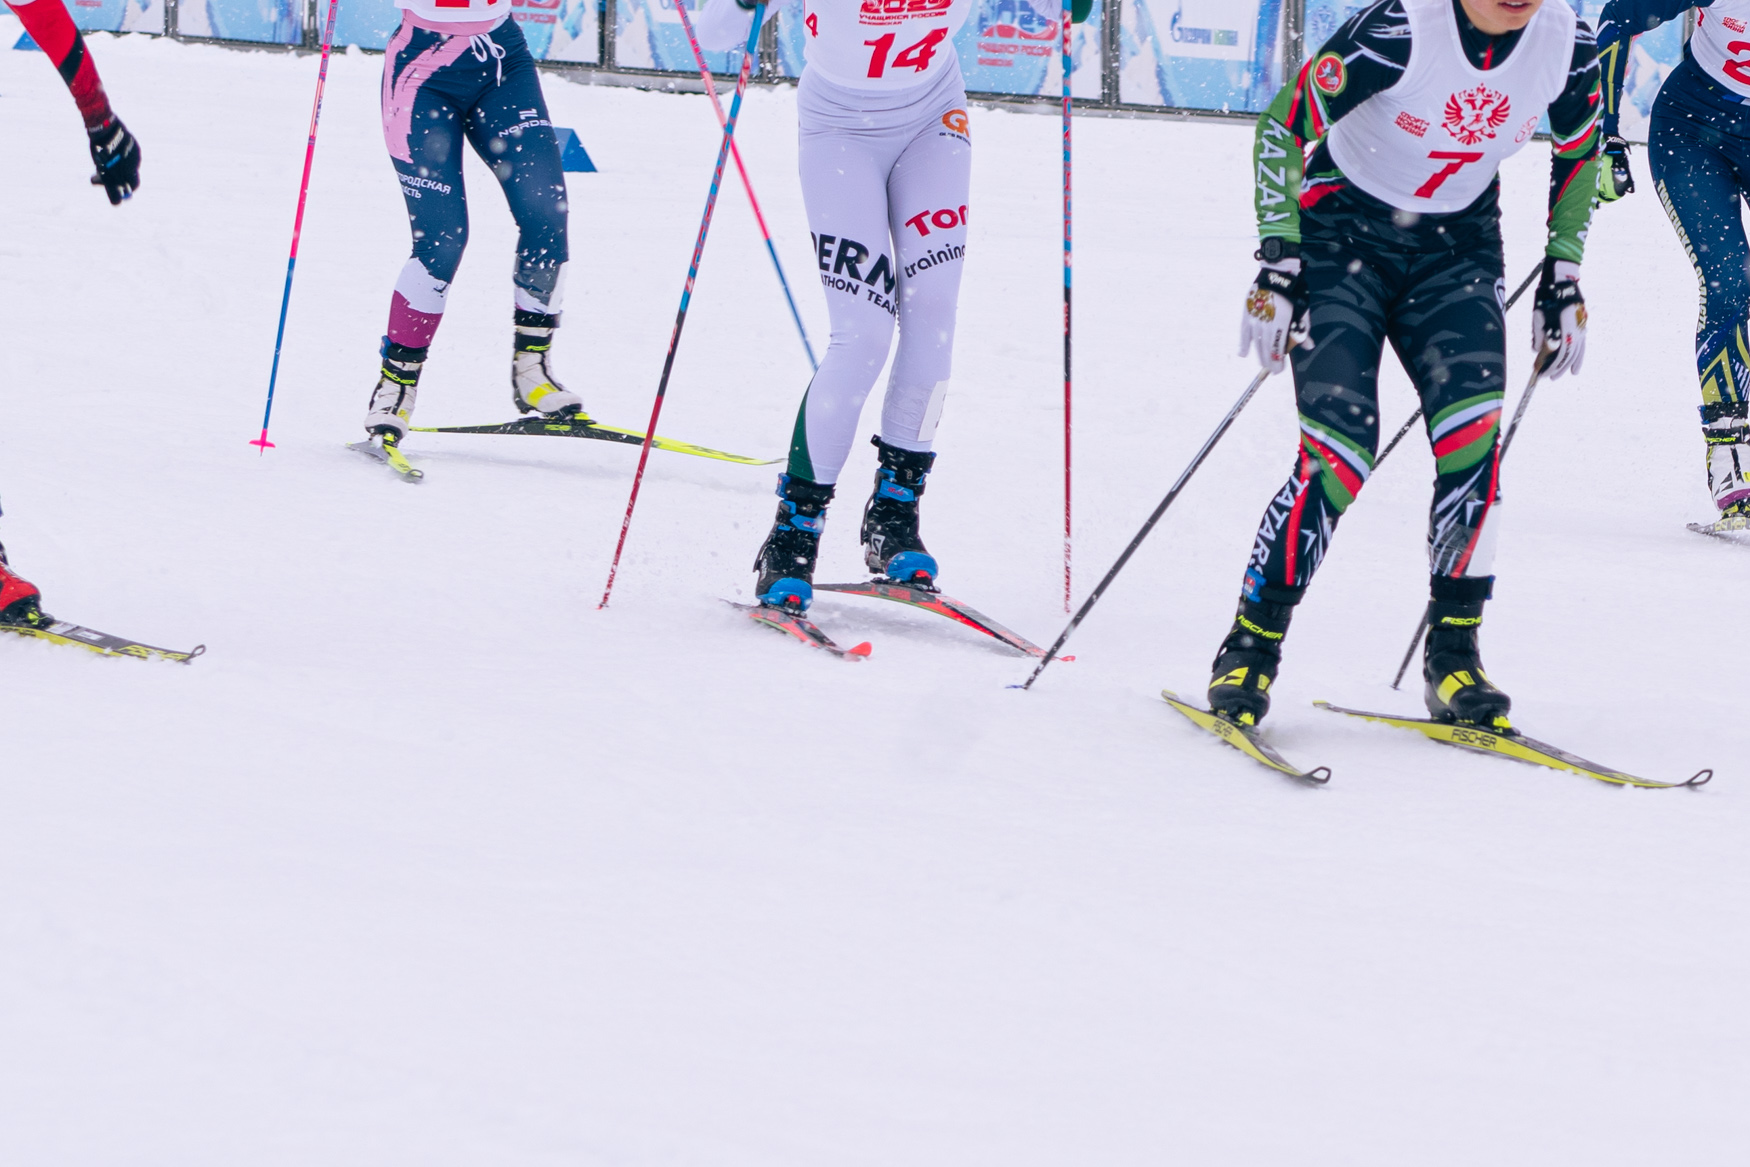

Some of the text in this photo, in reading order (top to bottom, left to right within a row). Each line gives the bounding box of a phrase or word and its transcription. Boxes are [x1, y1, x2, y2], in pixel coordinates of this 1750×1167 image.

[859, 10, 947, 21] УЧАЩИХСЯ РОССИИ
[863, 27, 949, 79] 14
[1258, 117, 1291, 222] KAZAN
[1413, 150, 1485, 200] 7
[1451, 727, 1498, 750] FISCHER
